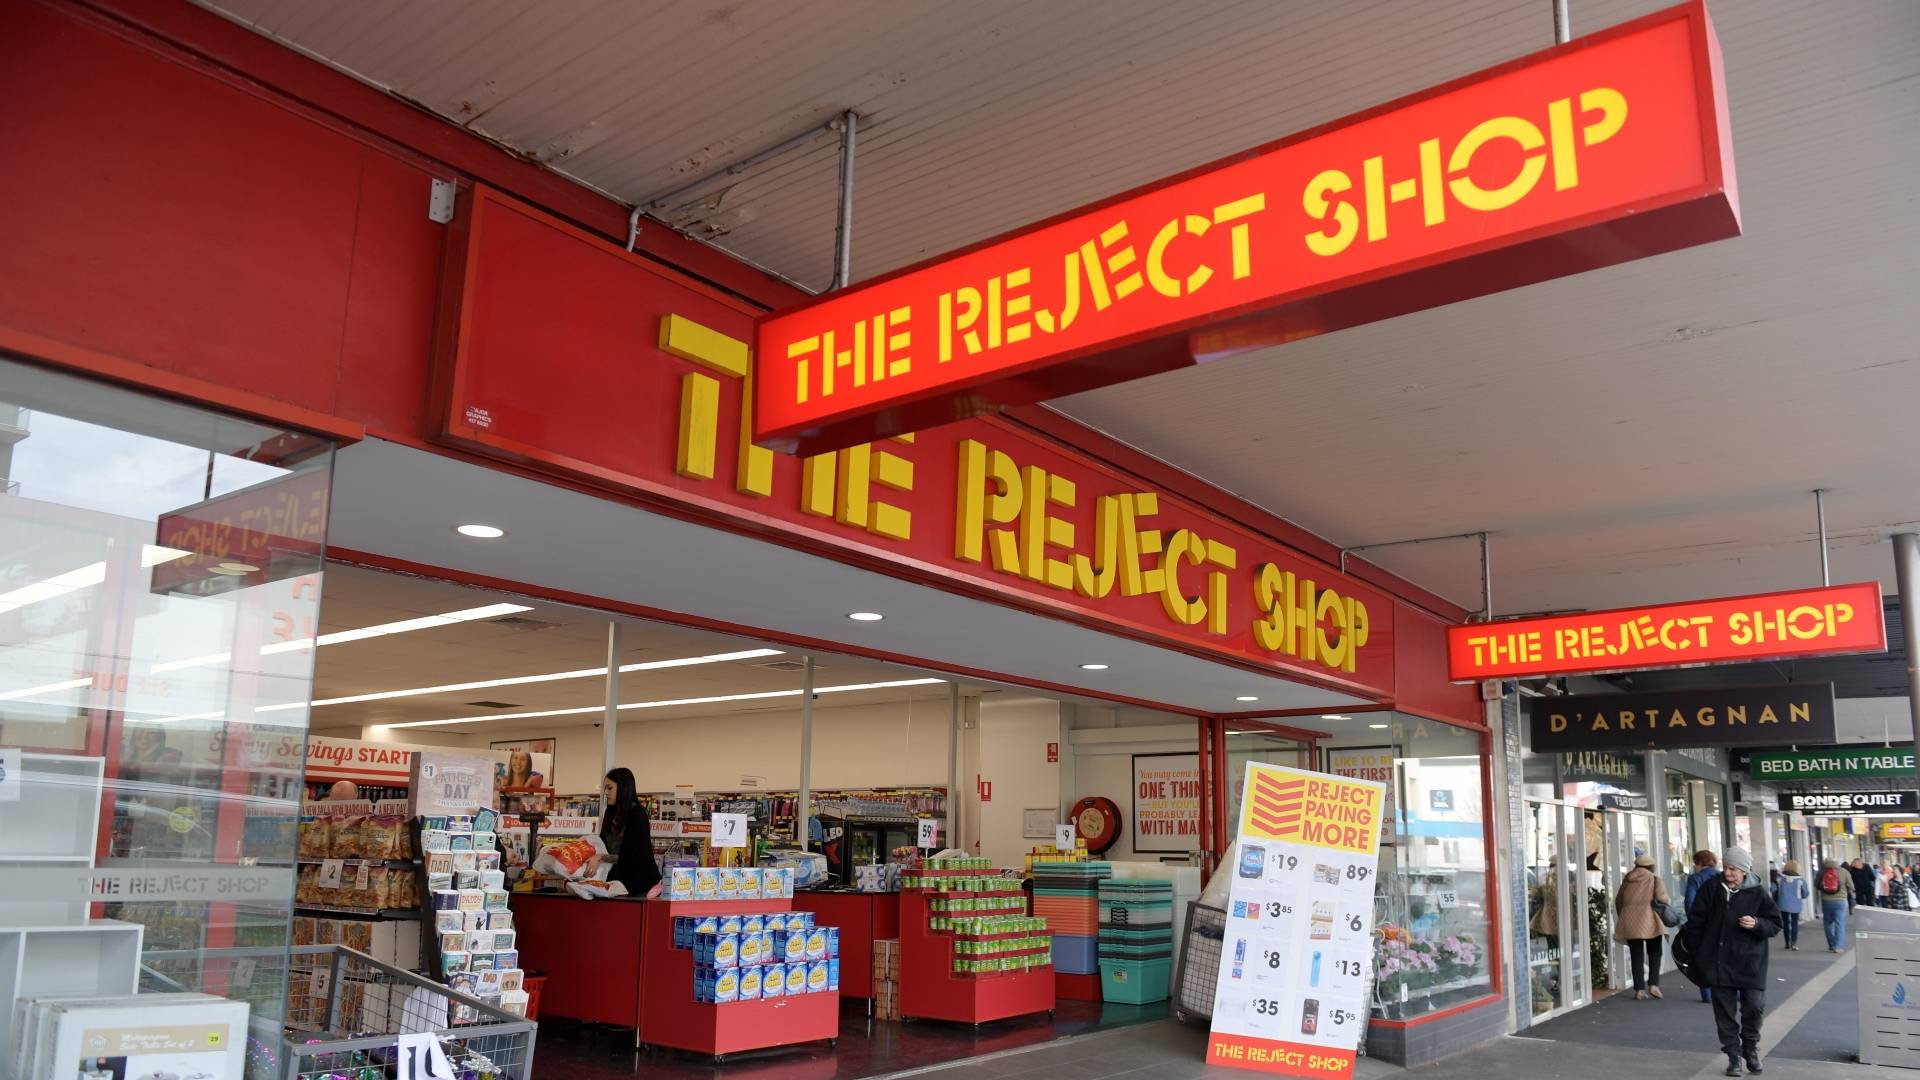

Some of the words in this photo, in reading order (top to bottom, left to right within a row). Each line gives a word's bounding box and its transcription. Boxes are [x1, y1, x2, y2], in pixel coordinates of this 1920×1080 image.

[787, 305, 911, 404] THE
[938, 192, 1265, 363] REJECT
[1302, 87, 1629, 257] SHOP
[954, 438, 1237, 636] REJECT
[1253, 562, 1369, 672] SHOP
[1467, 631, 1543, 667] THE
[1555, 615, 1714, 660] REJECT
[1729, 603, 1855, 647] SHOP
[1550, 701, 1811, 733] D'ARTAGNAN
[358, 747, 411, 765] START
[1761, 760, 1794, 773] BED
[1798, 758, 1841, 772] BATH
[1861, 755, 1915, 769] TABLE
[1361, 767, 1393, 780] FIRST
[443, 783, 471, 800] DAY
[1138, 782, 1166, 800] ONE
[1171, 781, 1205, 799] THIN
[1307, 780, 1375, 808] REJECT
[1792, 795, 1851, 806] BONDS
[1853, 793, 1903, 806] OUTLET
[1140, 810, 1184, 819] PROBABLY
[1305, 799, 1372, 826] PAYING
[554, 819, 586, 829] EVERYDAY
[723, 819, 736, 836] $7
[1140, 820, 1174, 836] WITH
[1302, 819, 1370, 850] MORE
[1271, 853, 1298, 871] $19
[1346, 864, 1373, 881] 89¢
[78, 876, 120, 895] THE
[129, 873, 208, 895] REJECT
[217, 877, 270, 894] SHOP
[1345, 913, 1363, 932] $6
[1264, 950, 1281, 969] $8
[1335, 960, 1361, 977] $13
[1252, 998, 1279, 1016] $35
[1214, 1043, 1244, 1060] THE
[1247, 1046, 1305, 1067] REJECT
[1308, 1055, 1349, 1072] SHOP
